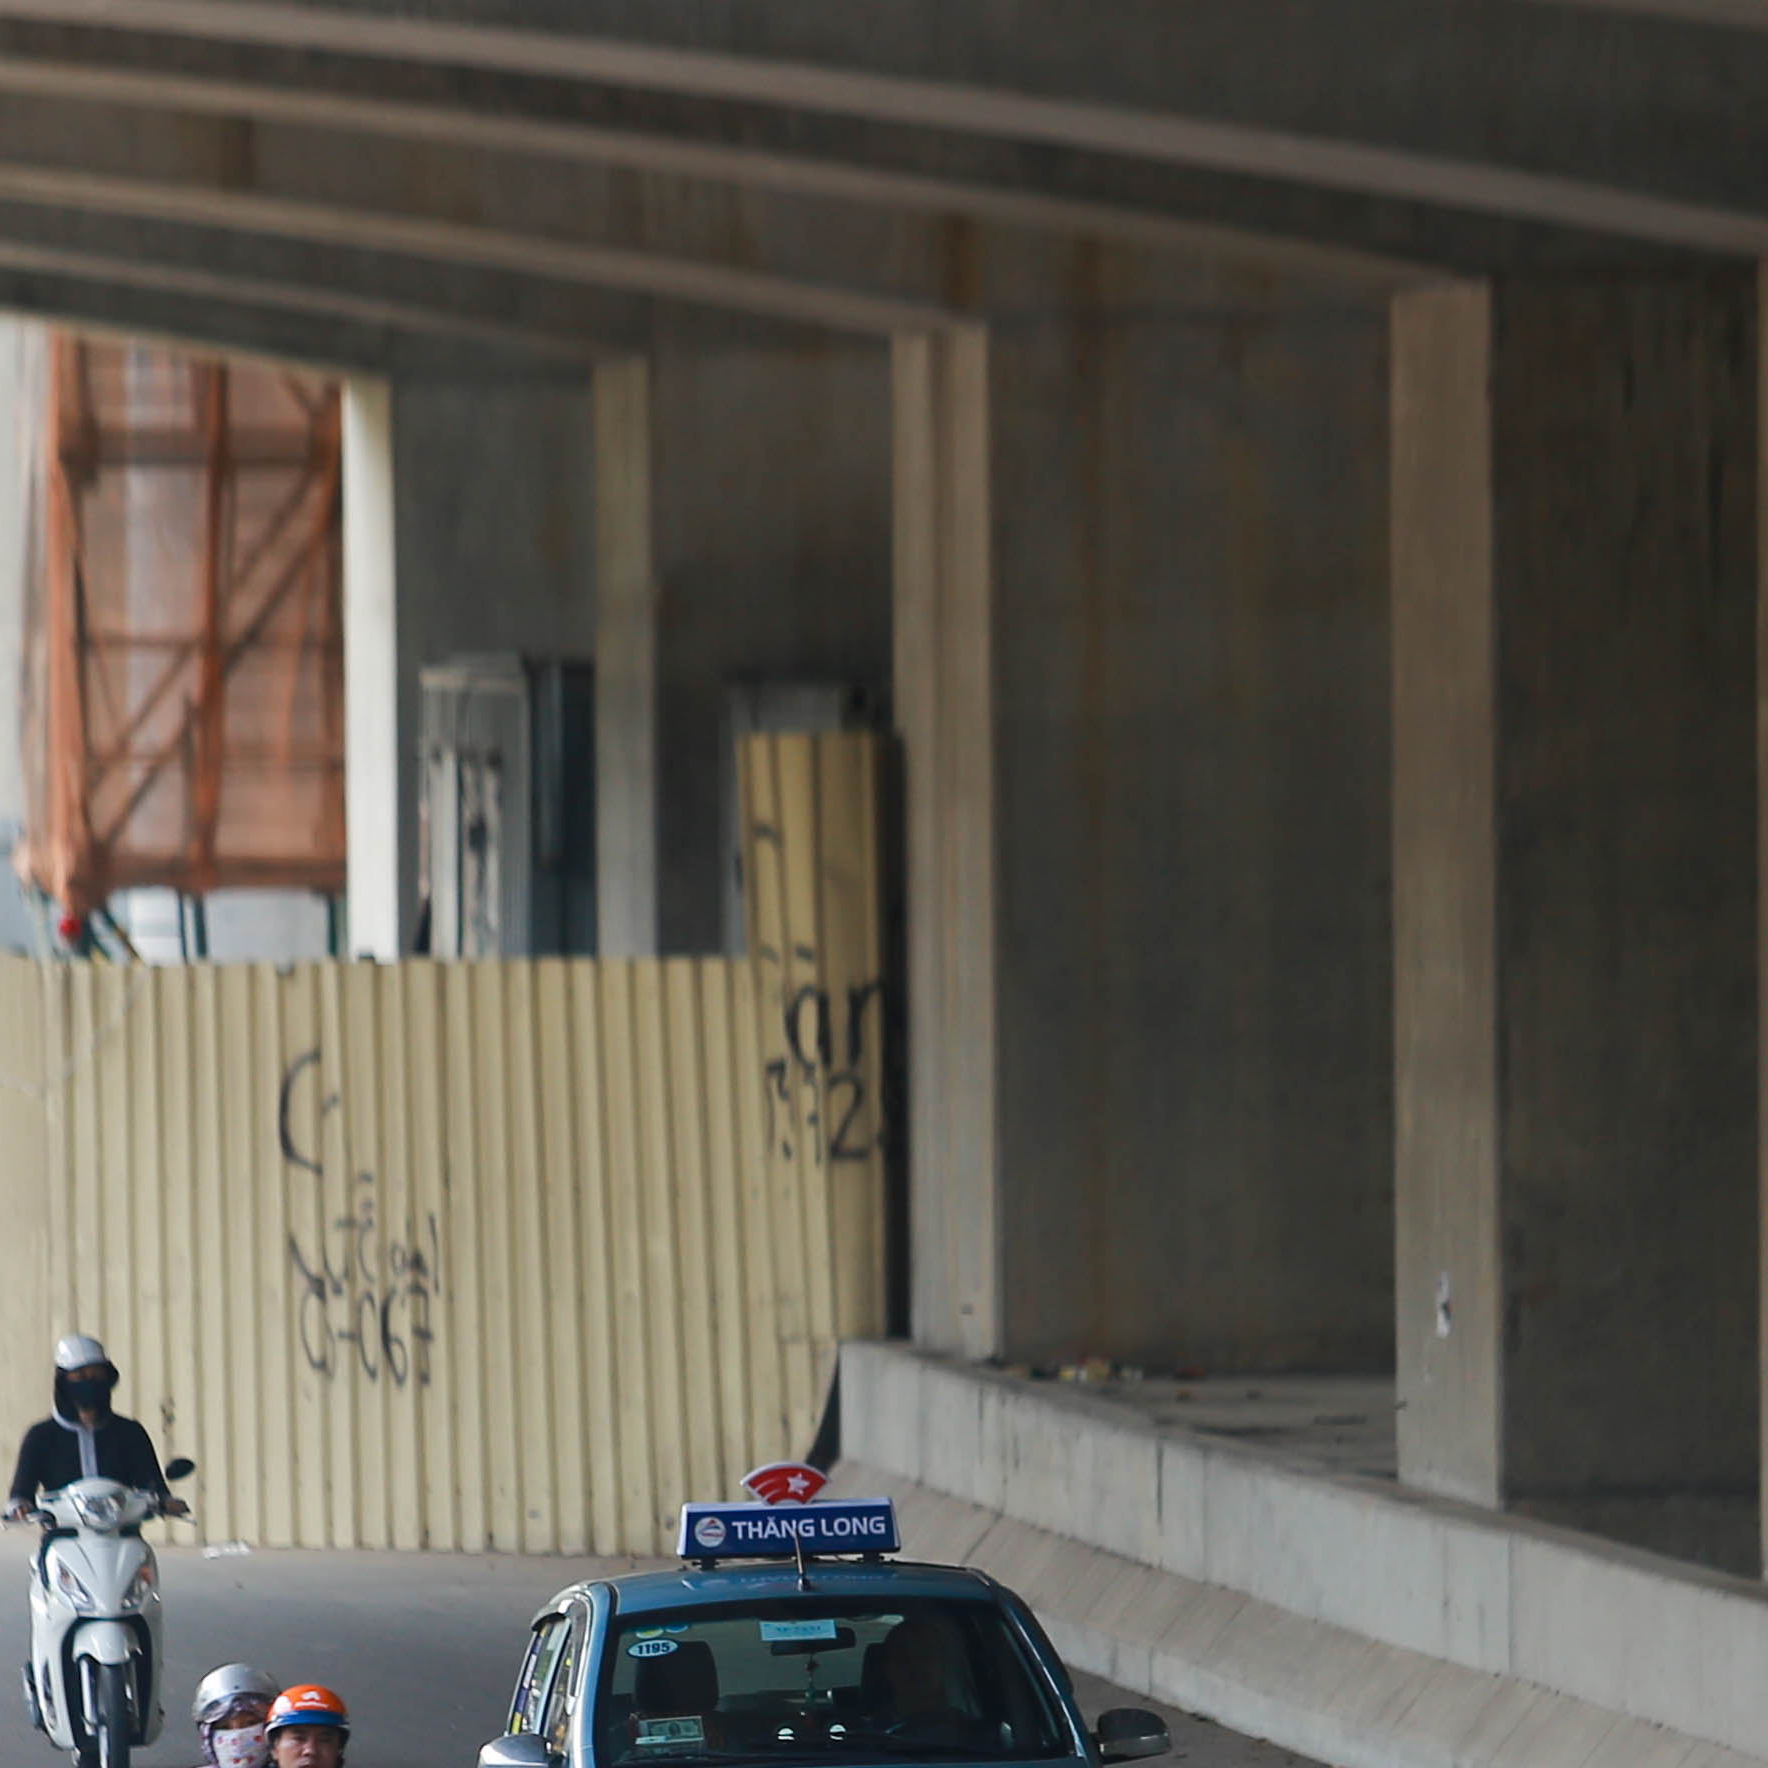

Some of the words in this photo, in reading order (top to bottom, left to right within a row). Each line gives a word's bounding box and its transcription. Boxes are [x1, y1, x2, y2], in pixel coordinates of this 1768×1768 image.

[732, 1515, 816, 1540] THĂNG
[820, 1516, 887, 1537] LONG
[637, 1641, 671, 1655] 1195
